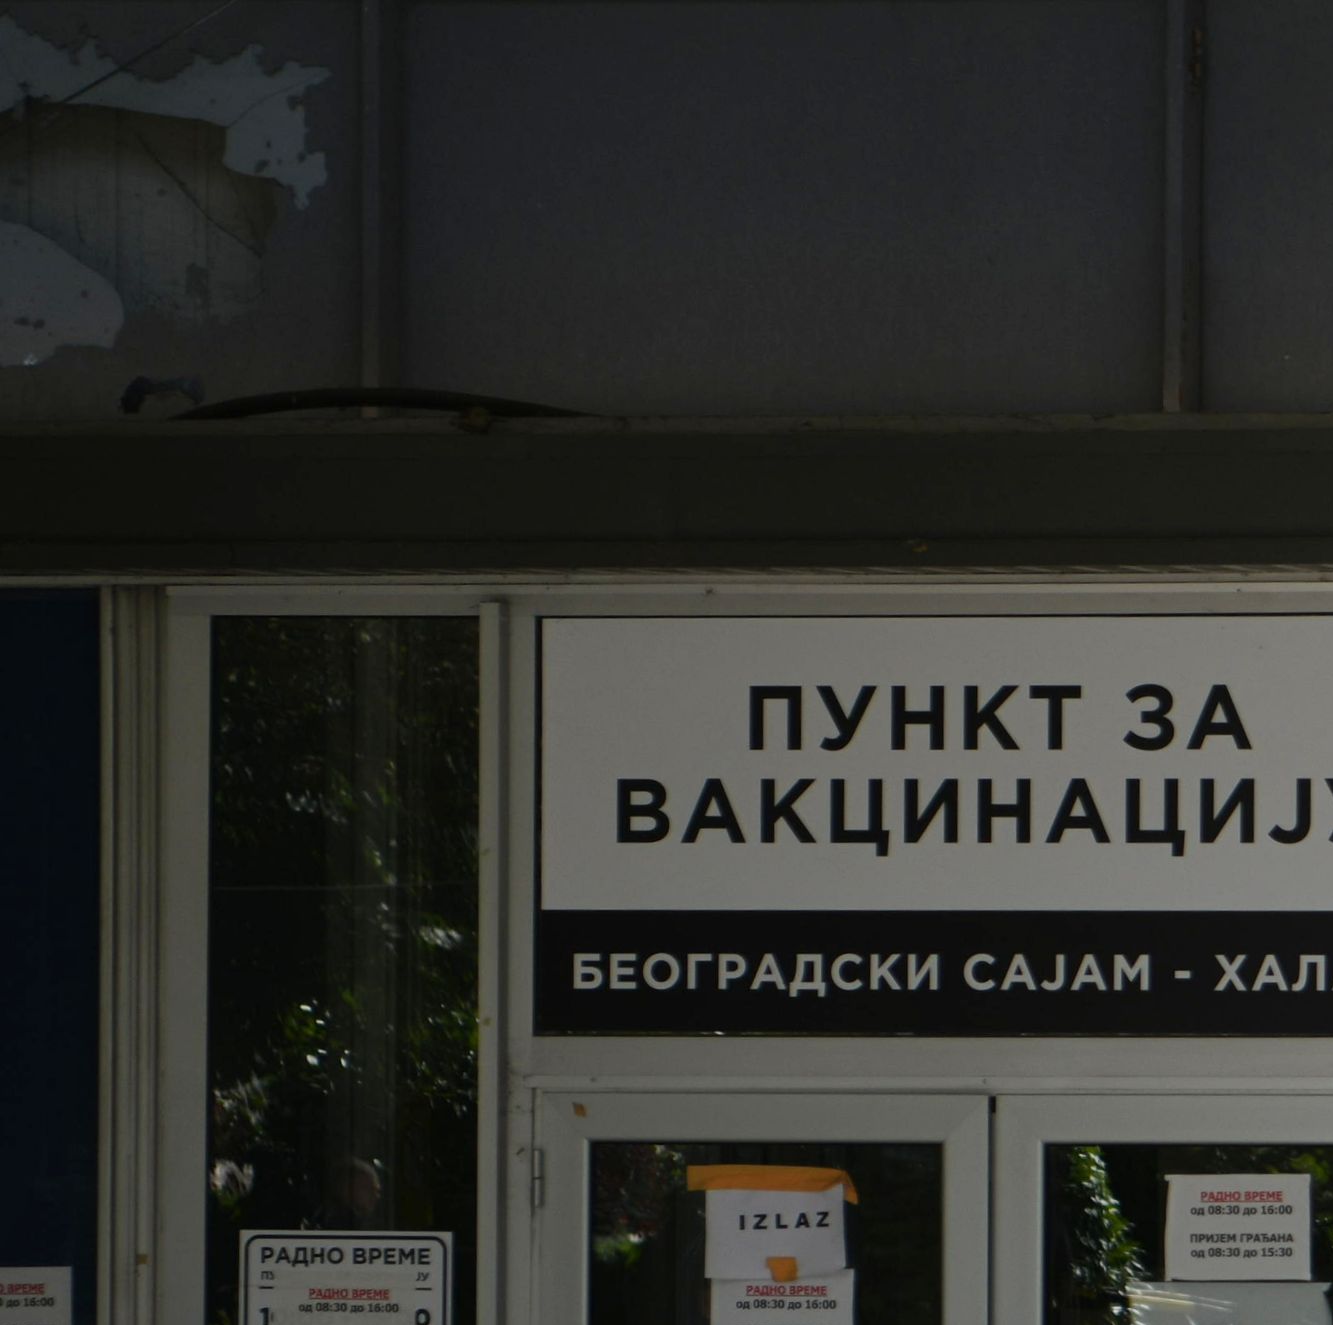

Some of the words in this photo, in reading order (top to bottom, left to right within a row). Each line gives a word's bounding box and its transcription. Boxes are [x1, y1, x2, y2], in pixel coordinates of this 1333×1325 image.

[748, 685, 1082, 751] ПУНКТ
[1124, 684, 1252, 751] ЗА
[572, 954, 940, 997] БЕОГРАДСКИ
[964, 953, 1151, 992] САЈАМ
[1200, 1191, 1241, 1202] РАДНО
[1245, 1191, 1283, 1202] ВРЕМЕ
[1191, 1207, 1205, 1216] од
[1208, 1205, 1240, 1215] 08:30
[1243, 1207, 1257, 1216] до
[1262, 1205, 1293, 1215] 16:00
[738, 1211, 830, 1230] IZLAZ
[1190, 1233, 1236, 1243] ПРИЈЕМ
[1240, 1233, 1294, 1243] ГРАЂАНА
[261, 1247, 344, 1267] РАДНО
[353, 1248, 431, 1265] ВРЕМЕ
[1191, 1249, 1205, 1258] од
[1208, 1247, 1240, 1257] 08:30
[1243, 1249, 1257, 1258] до
[1262, 1247, 1293, 1257] 15:30
[309, 1288, 348, 1299] РАДНО
[353, 1288, 389, 1300] ВРЕМЕ
[746, 1285, 786, 1296] РАДНО
[789, 1285, 827, 1296] ВРЕМЕ
[298, 1304, 313, 1313] од
[315, 1303, 347, 1312] 08:30
[350, 1304, 364, 1314] до
[368, 1303, 399, 1313] 16:00
[736, 1301, 750, 1309] од
[753, 1299, 785, 1309] 08:30
[788, 1301, 802, 1310] до
[805, 1300, 837, 1309] 16:00
